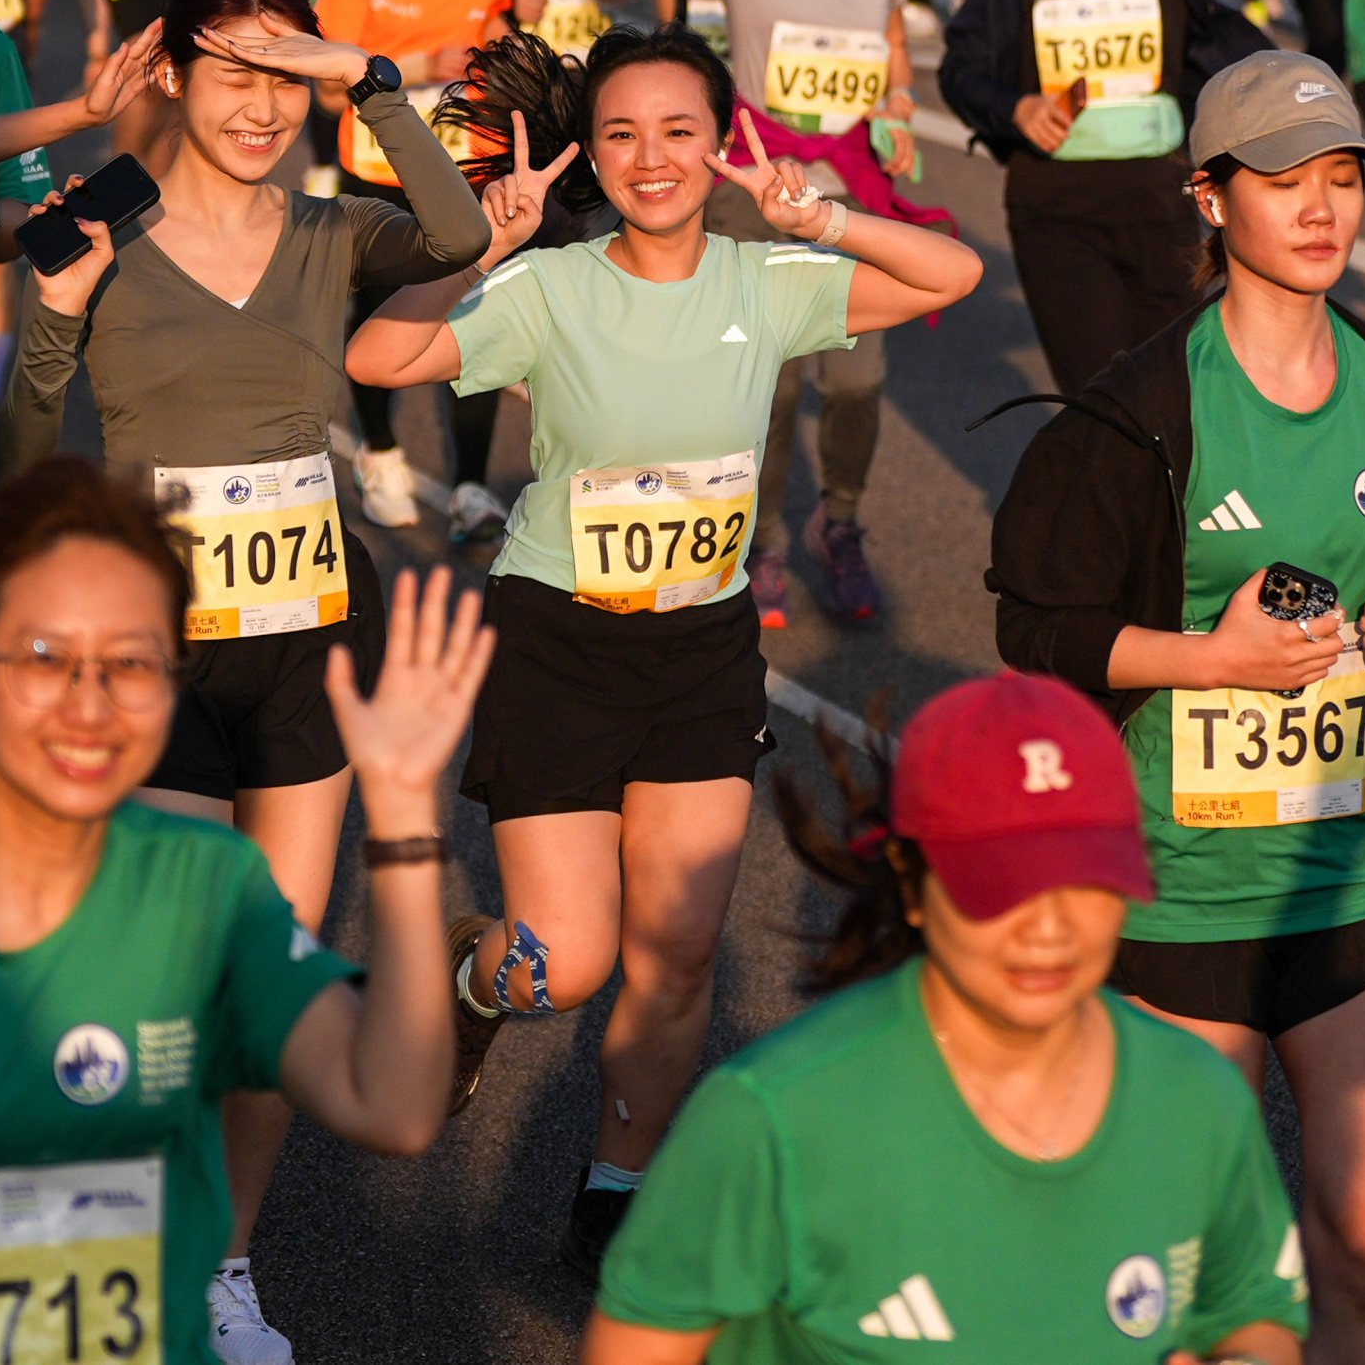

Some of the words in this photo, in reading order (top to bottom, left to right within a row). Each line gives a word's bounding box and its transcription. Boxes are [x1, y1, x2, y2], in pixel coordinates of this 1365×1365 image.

[1044, 32, 1156, 73] T3676
[776, 64, 881, 106] V3499
[1300, 81, 1326, 94] NIKE
[585, 511, 745, 575] T0782
[195, 625, 213, 635] Run
[215, 625, 221, 634] 7
[1019, 740, 1073, 793] R
[1187, 811, 1212, 821] 10km
[1215, 811, 1235, 821] Run
[1237, 810, 1243, 820] 7
[1188, 799, 1241, 811] 十公里七組
